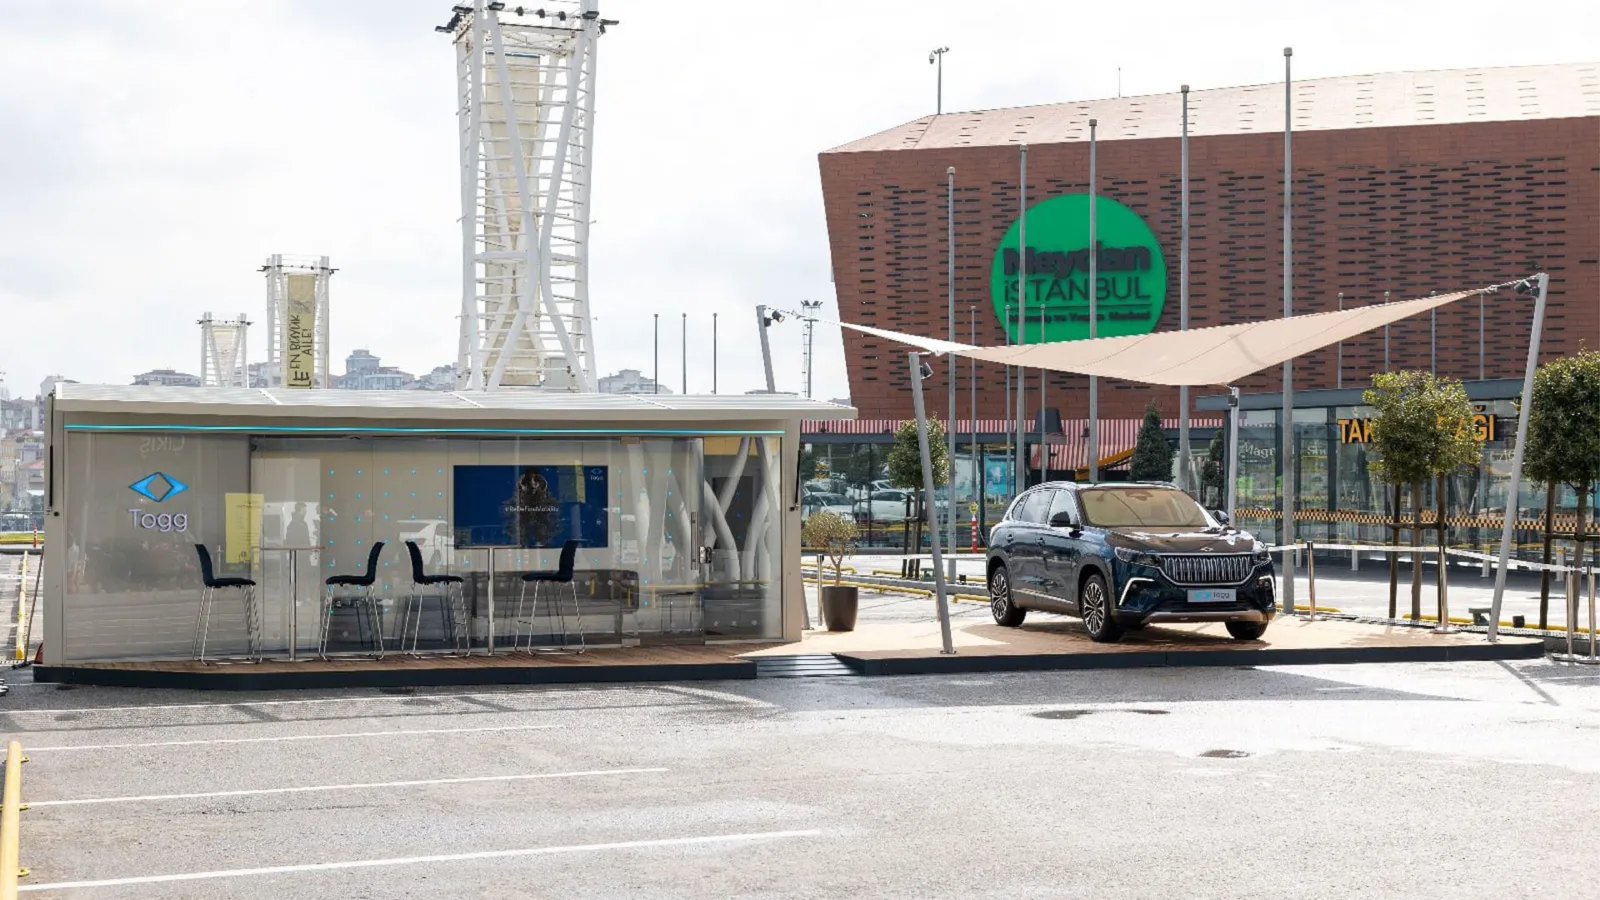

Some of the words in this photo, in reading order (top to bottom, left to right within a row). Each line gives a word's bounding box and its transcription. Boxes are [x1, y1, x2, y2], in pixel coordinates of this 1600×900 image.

[1003, 241, 1151, 279] Meydan
[289, 354, 302, 369] EN
[128, 508, 188, 532] Togg
